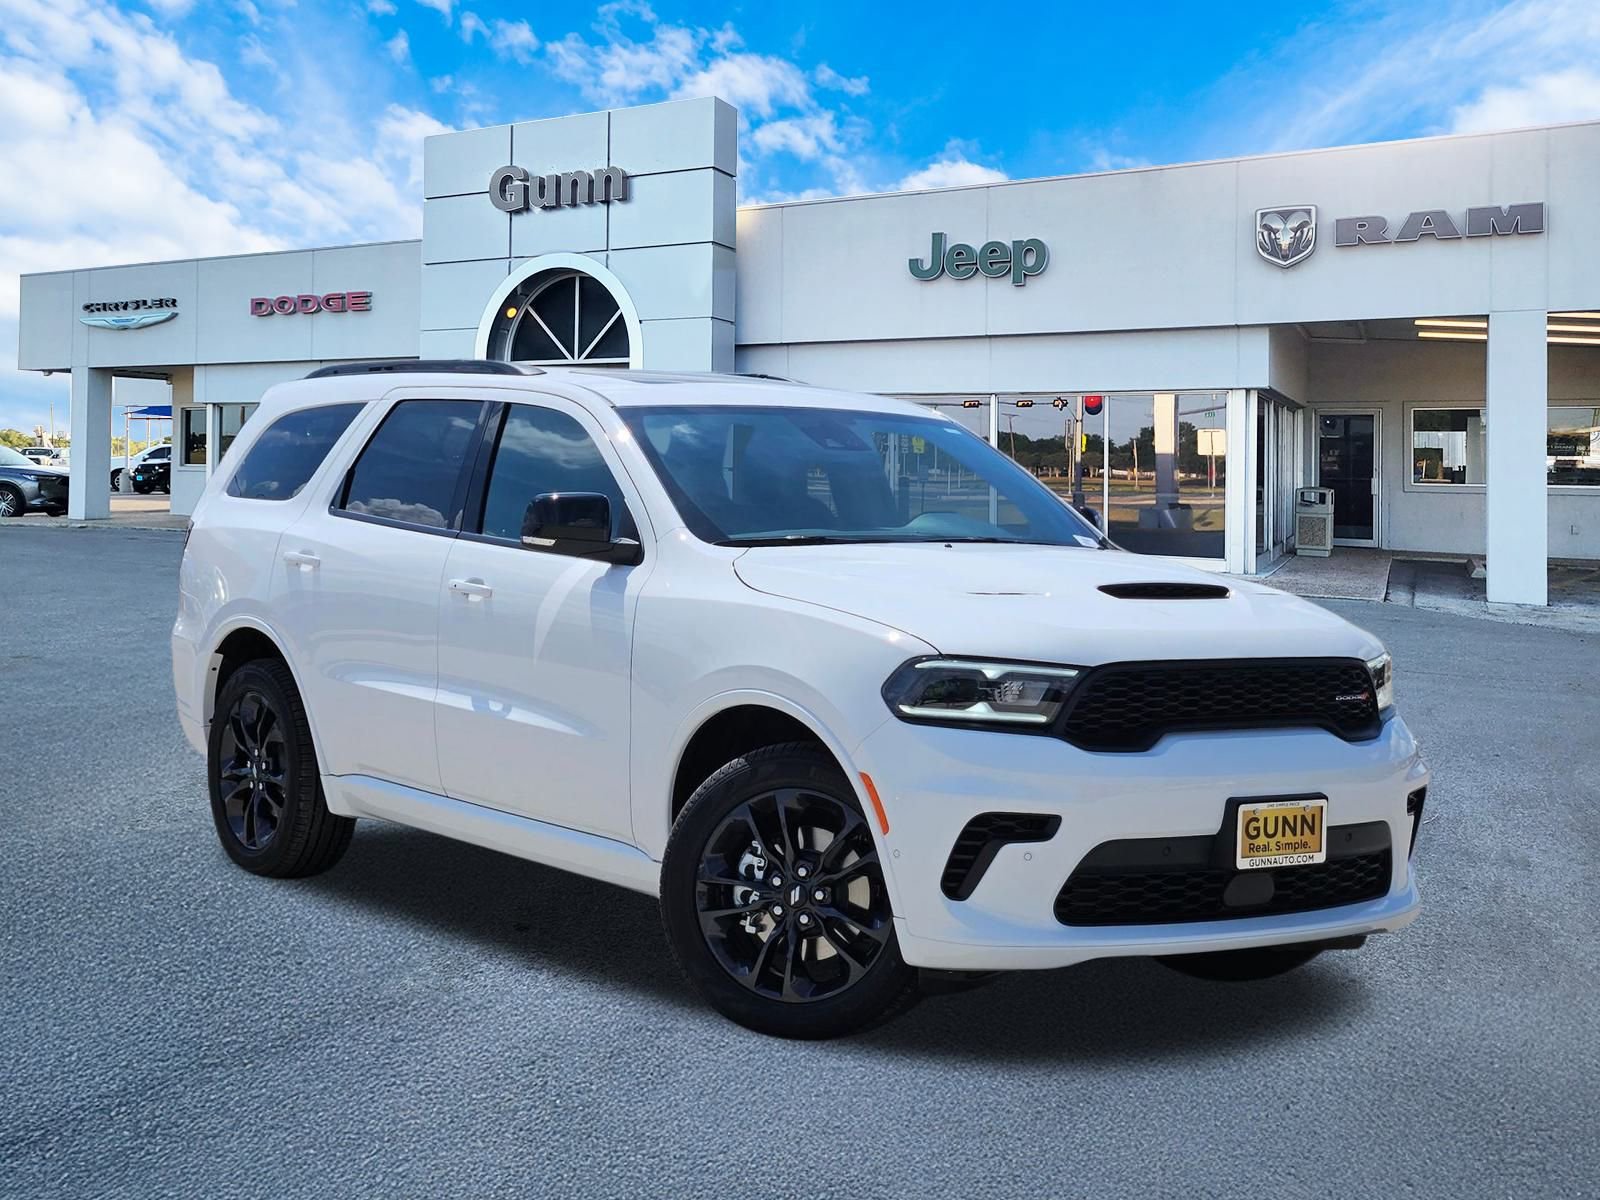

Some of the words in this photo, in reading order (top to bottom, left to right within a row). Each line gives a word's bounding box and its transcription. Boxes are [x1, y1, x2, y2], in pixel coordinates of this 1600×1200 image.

[489, 165, 628, 213] Gunn
[1335, 202, 1545, 247] RAM
[908, 232, 1049, 286] Jeep
[82, 298, 178, 313] CHRYSLER
[250, 292, 373, 317] DODGE
[1244, 813, 1316, 840] GUNN
[1248, 842, 1273, 854] Real.
[1275, 839, 1311, 852] Simple.
[1248, 854, 1315, 868] GUNNAUTO.COM
